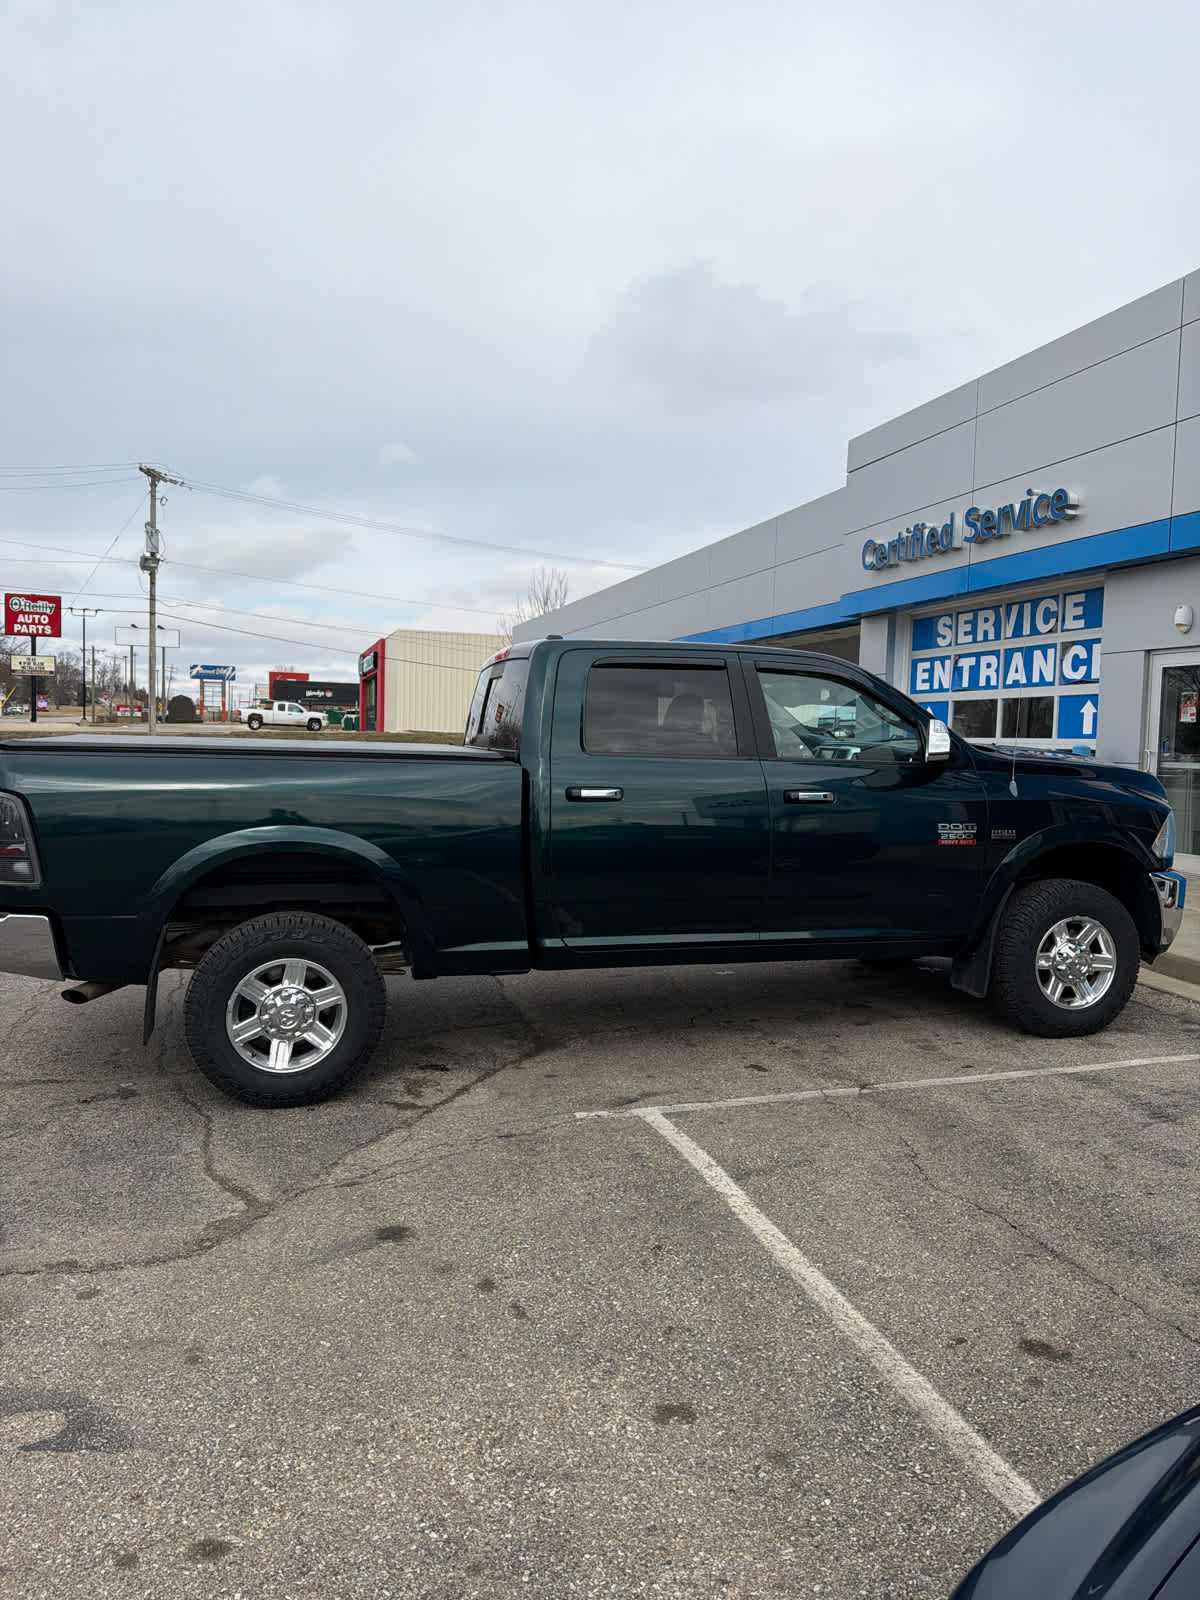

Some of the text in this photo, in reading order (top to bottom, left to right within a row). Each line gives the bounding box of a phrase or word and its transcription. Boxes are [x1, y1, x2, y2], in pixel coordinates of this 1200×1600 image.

[862, 488, 1070, 571] Certified Service
[10, 597, 55, 614] O'Reilly
[17, 614, 49, 624] AUTO
[936, 593, 1086, 648] SERVICE
[14, 624, 52, 634] PARTS
